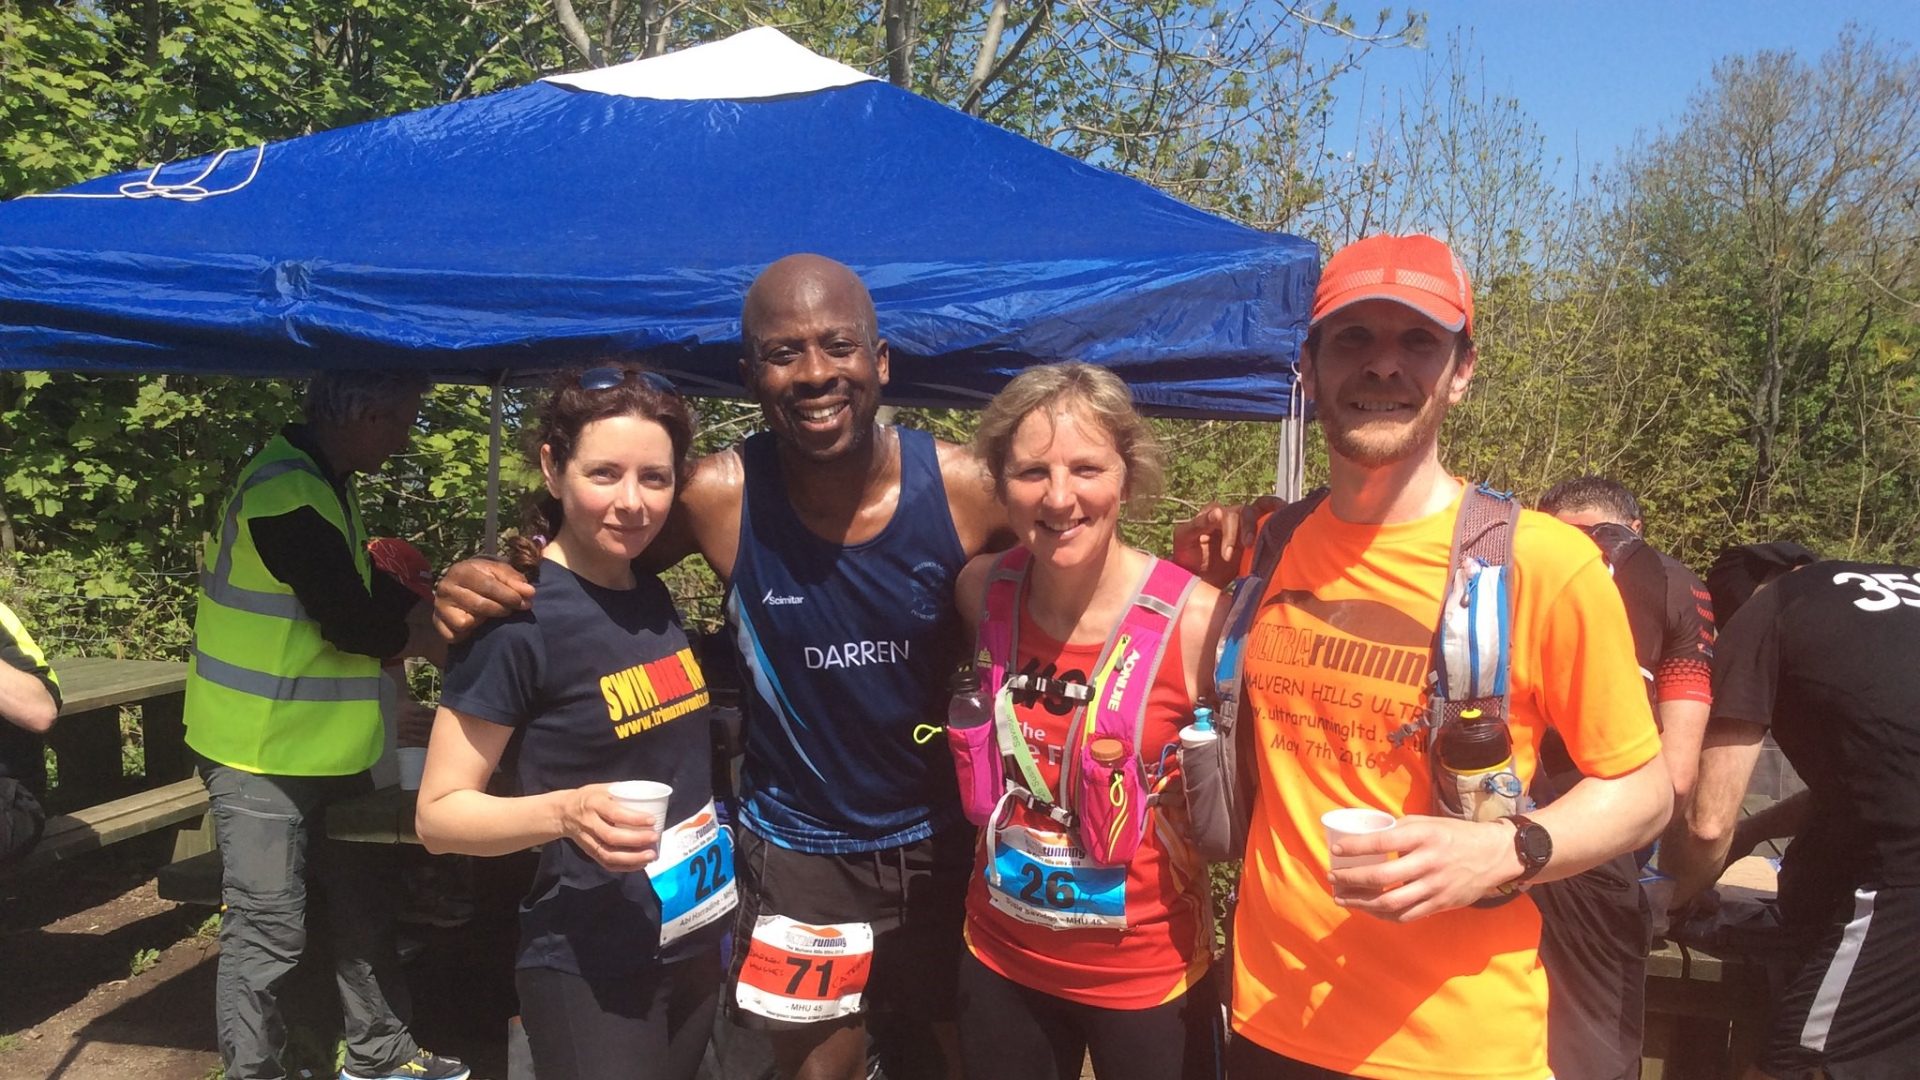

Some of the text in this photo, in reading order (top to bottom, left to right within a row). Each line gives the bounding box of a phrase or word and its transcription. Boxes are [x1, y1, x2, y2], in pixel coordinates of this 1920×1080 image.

[768, 596, 804, 605] Scimitar
[804, 640, 909, 669] DARREN
[1311, 682, 1363, 708] HILLS
[1371, 695, 1424, 722] ULTR
[1019, 721, 1046, 741] he
[1270, 734, 1300, 757] May
[1305, 740, 1332, 760] 7th
[689, 844, 727, 902] 22
[1021, 862, 1075, 908] 26
[785, 956, 834, 997] 71
[791, 1003, 812, 1012] MHU
